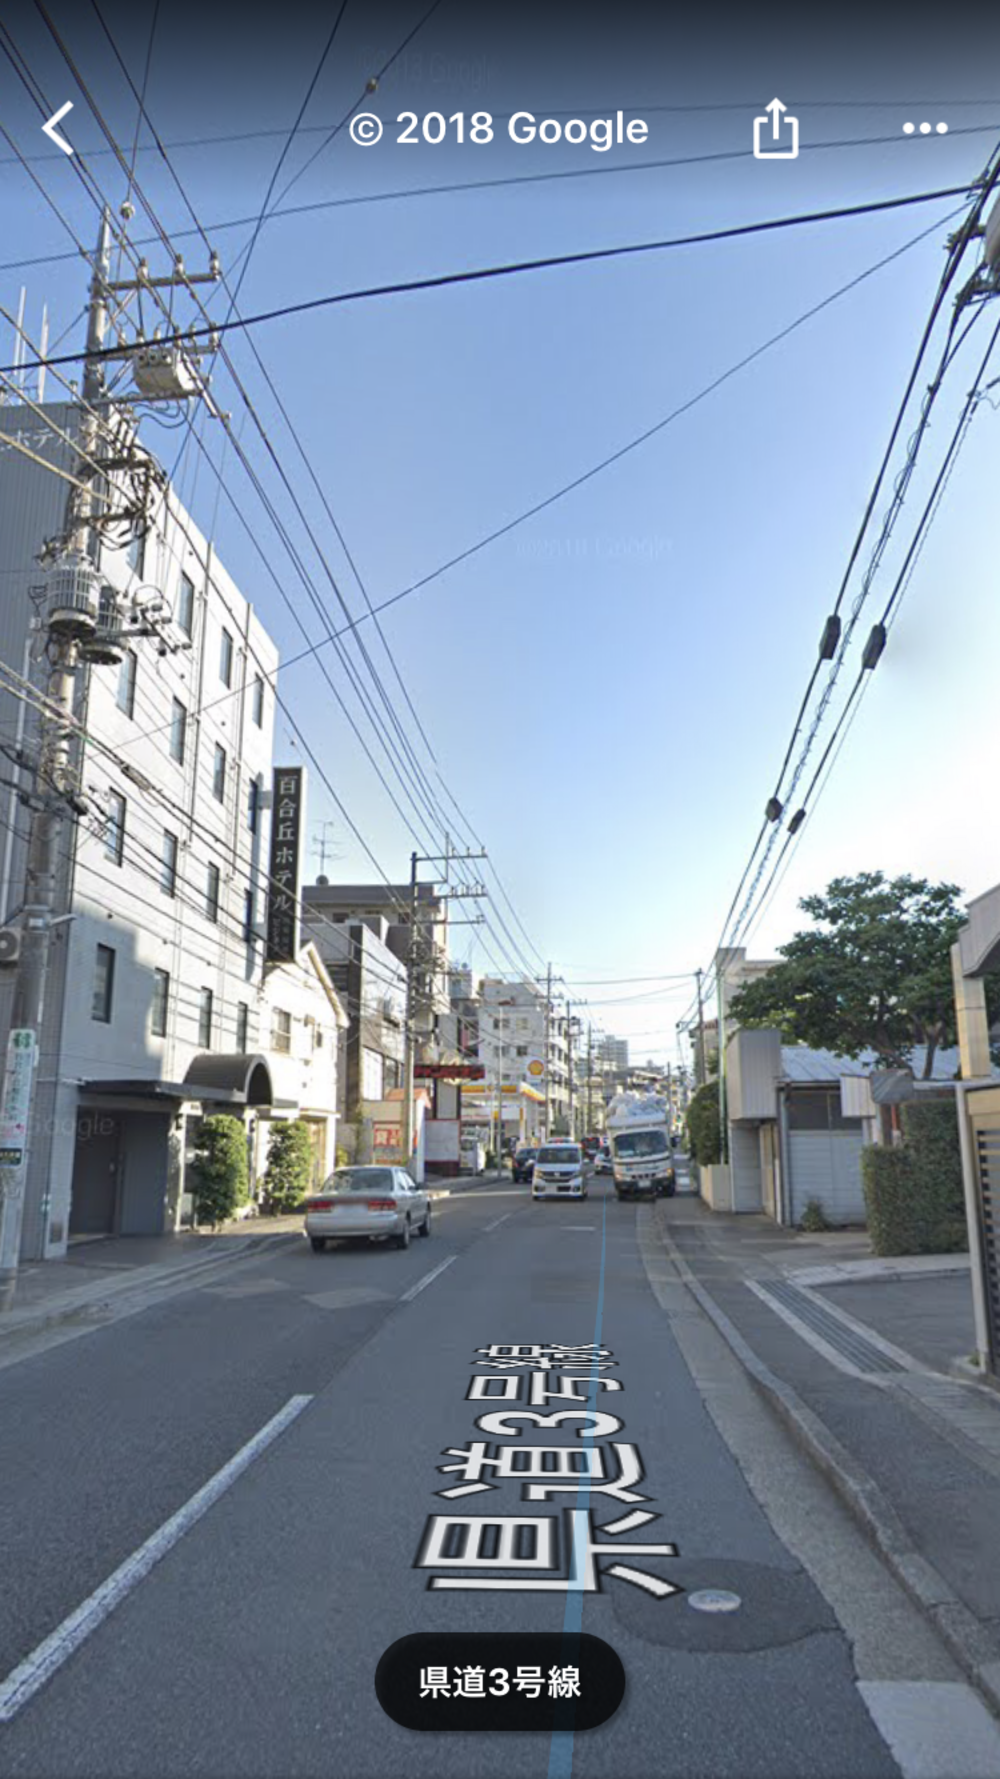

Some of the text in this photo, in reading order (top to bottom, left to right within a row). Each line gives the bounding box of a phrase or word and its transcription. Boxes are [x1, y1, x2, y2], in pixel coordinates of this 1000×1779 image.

[274, 775, 298, 912] 百合丘ホテル
